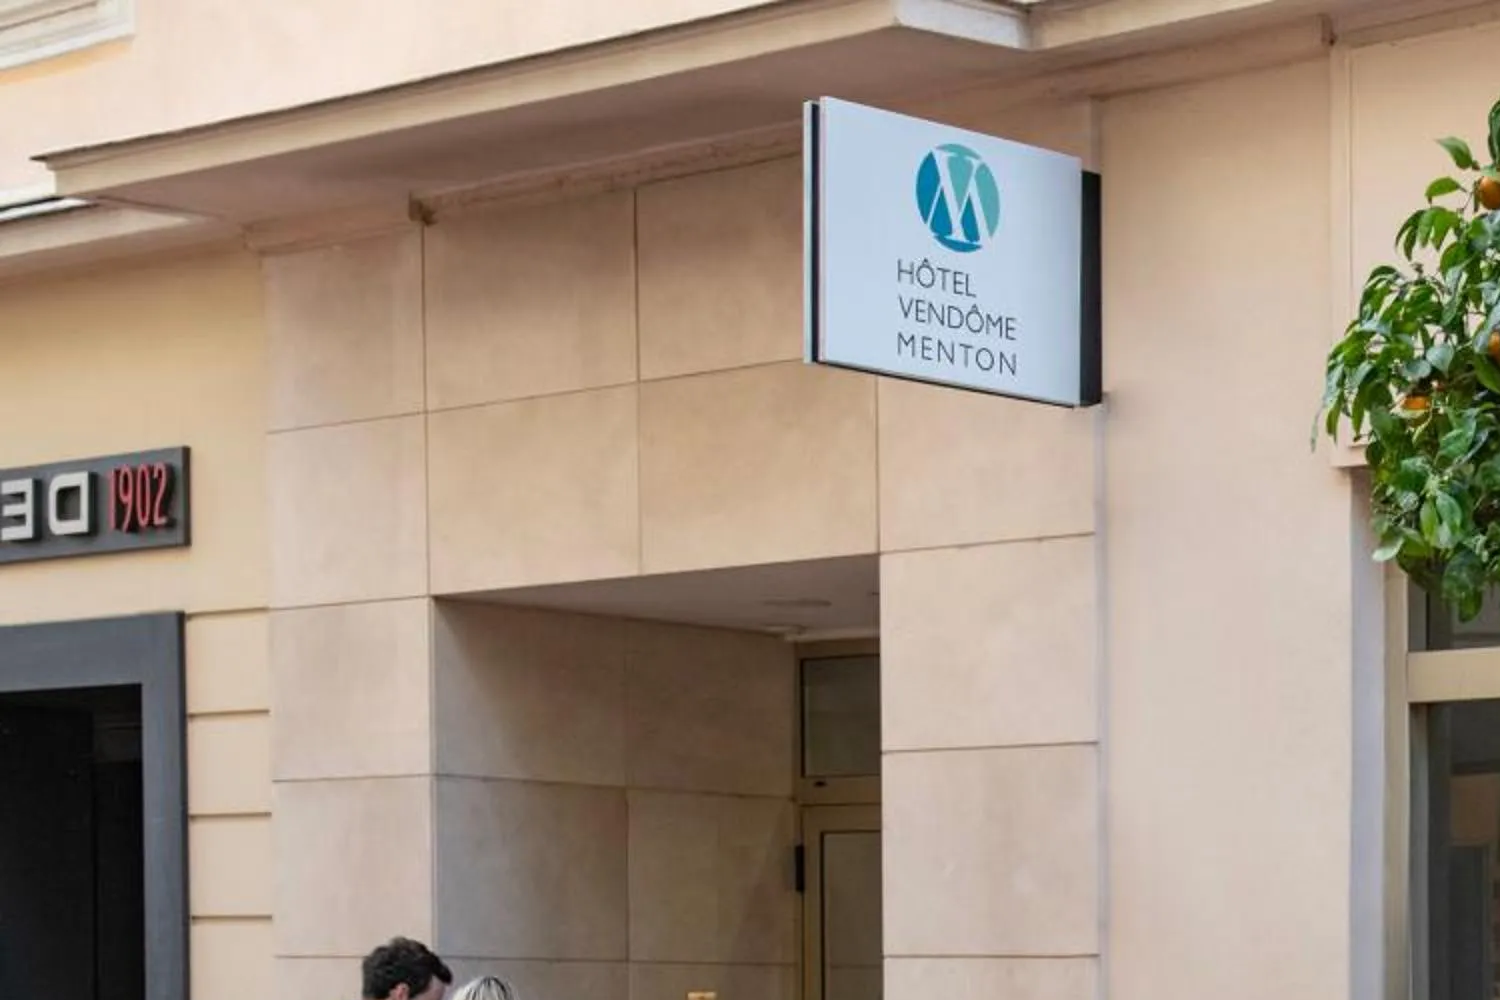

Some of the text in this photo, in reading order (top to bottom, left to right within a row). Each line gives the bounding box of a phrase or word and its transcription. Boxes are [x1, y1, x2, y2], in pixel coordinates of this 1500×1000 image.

[897, 258, 977, 298] HÔTEL
[898, 295, 1017, 341] VENDÔME
[897, 331, 1017, 376] MENTON
[107, 461, 169, 534] 1902
